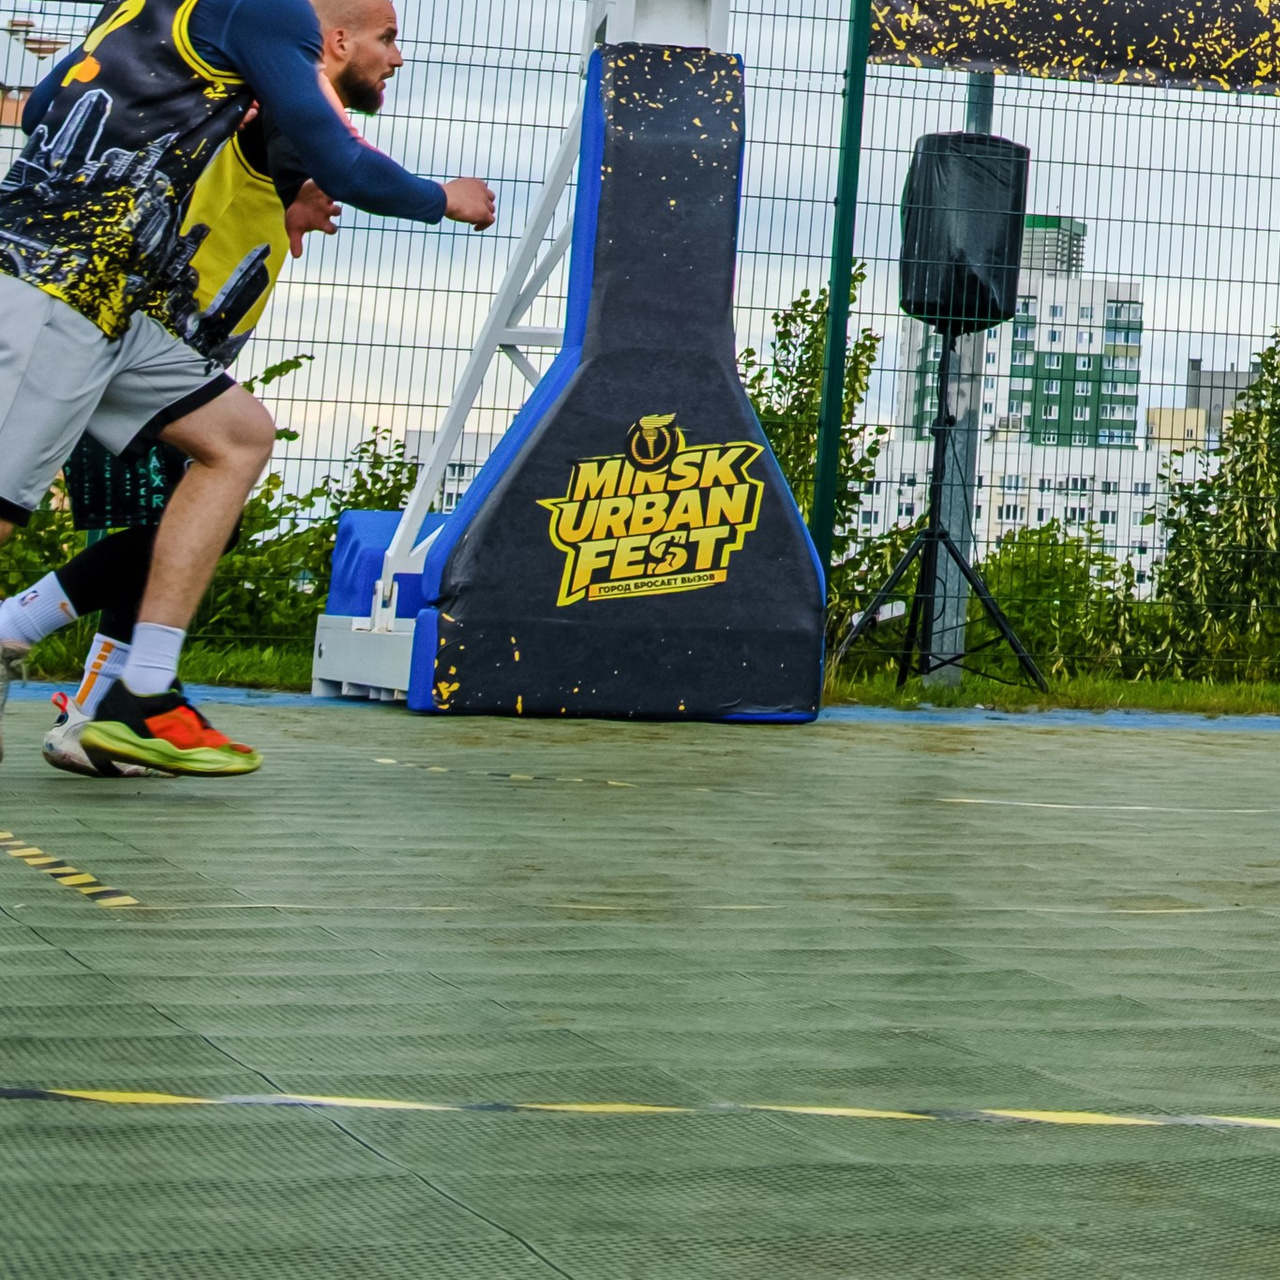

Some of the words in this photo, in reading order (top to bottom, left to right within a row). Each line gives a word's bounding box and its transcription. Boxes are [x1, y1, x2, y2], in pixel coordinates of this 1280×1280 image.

[572, 446, 748, 501] MINSK
[558, 483, 750, 543] URBAN
[571, 526, 730, 594] FEST
[598, 583, 632, 594] ГОРОД
[633, 577, 679, 590] БРОСАЕТ
[681, 573, 716, 584] ВЫЗОВ
